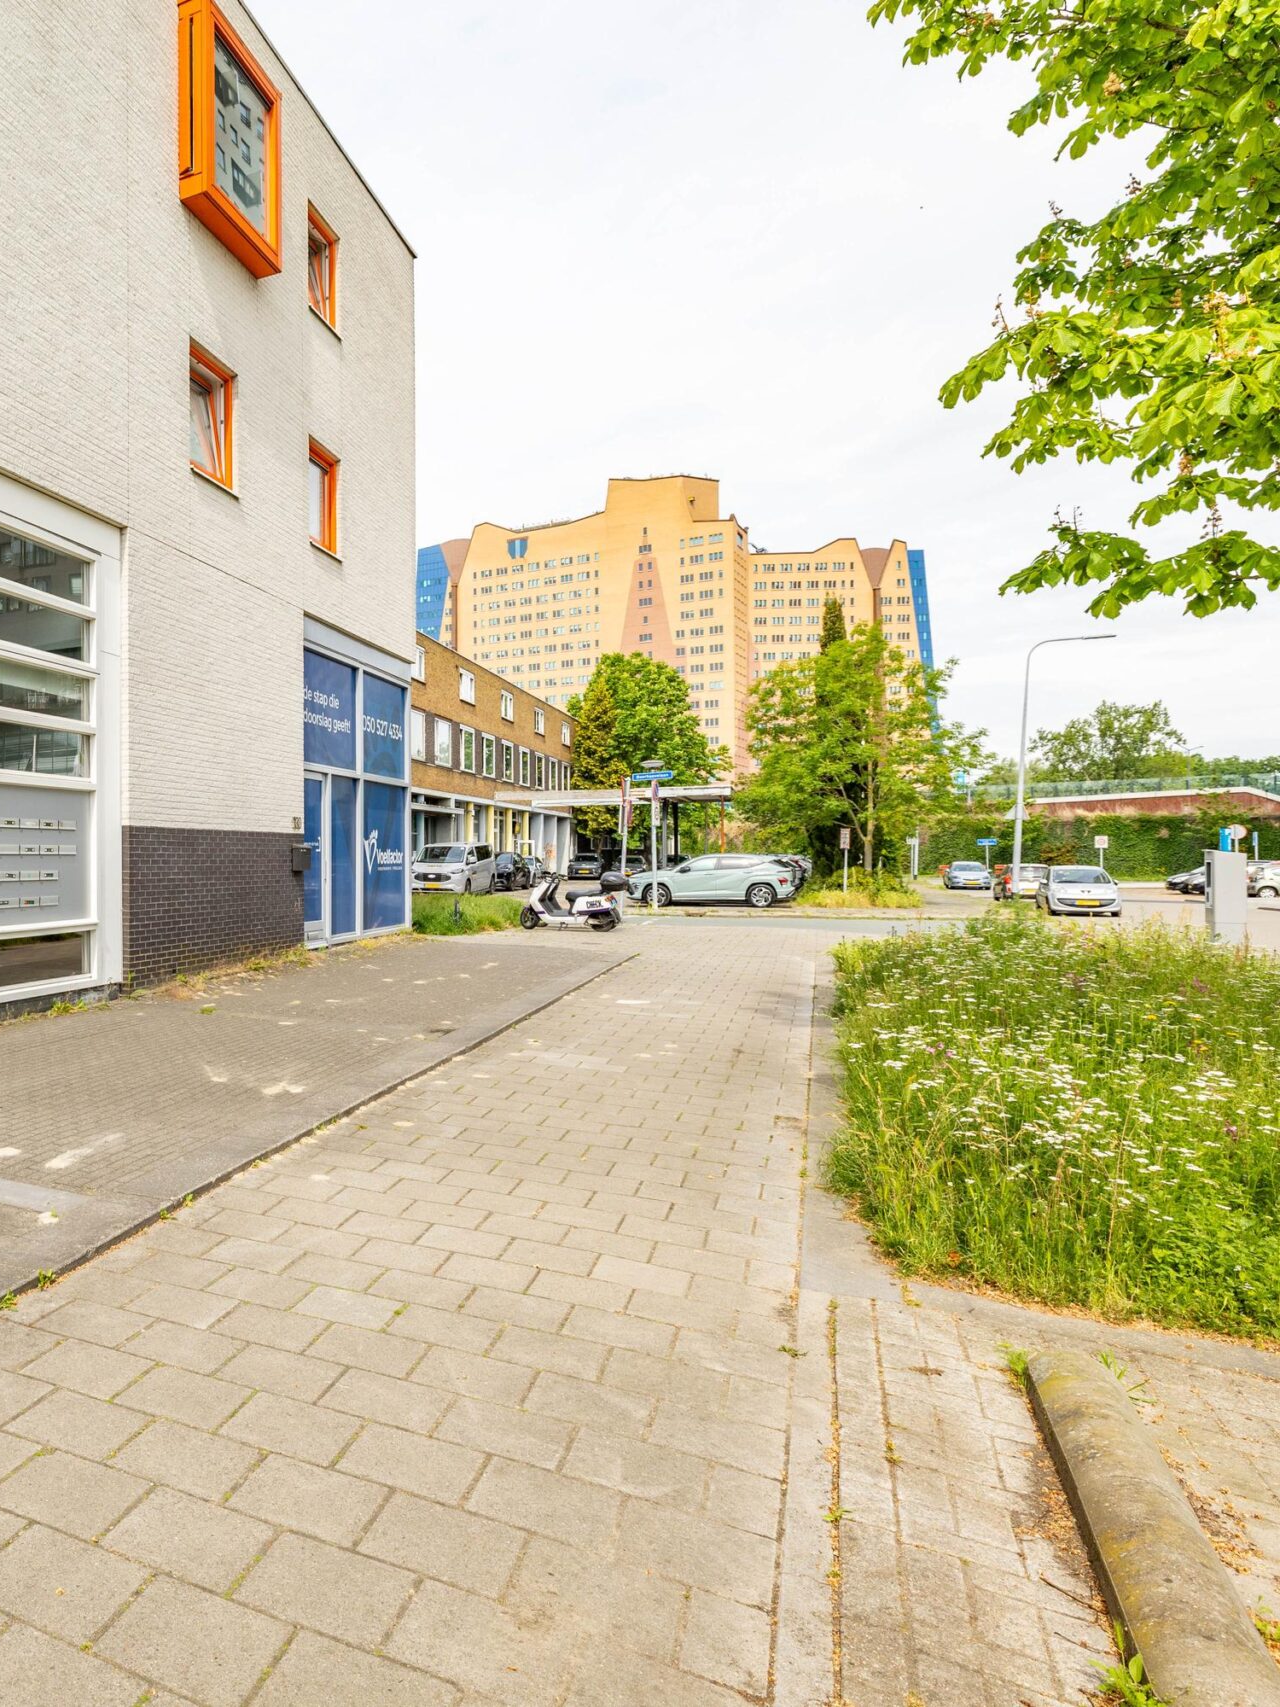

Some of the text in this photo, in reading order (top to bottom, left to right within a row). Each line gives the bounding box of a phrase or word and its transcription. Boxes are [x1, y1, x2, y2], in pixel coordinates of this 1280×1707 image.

[314, 690, 328, 708] stap
[329, 694, 340, 710] die
[304, 708, 351, 734] doorslag geeft!
[376, 719, 388, 737] 527
[388, 723, 403, 741] 4334
